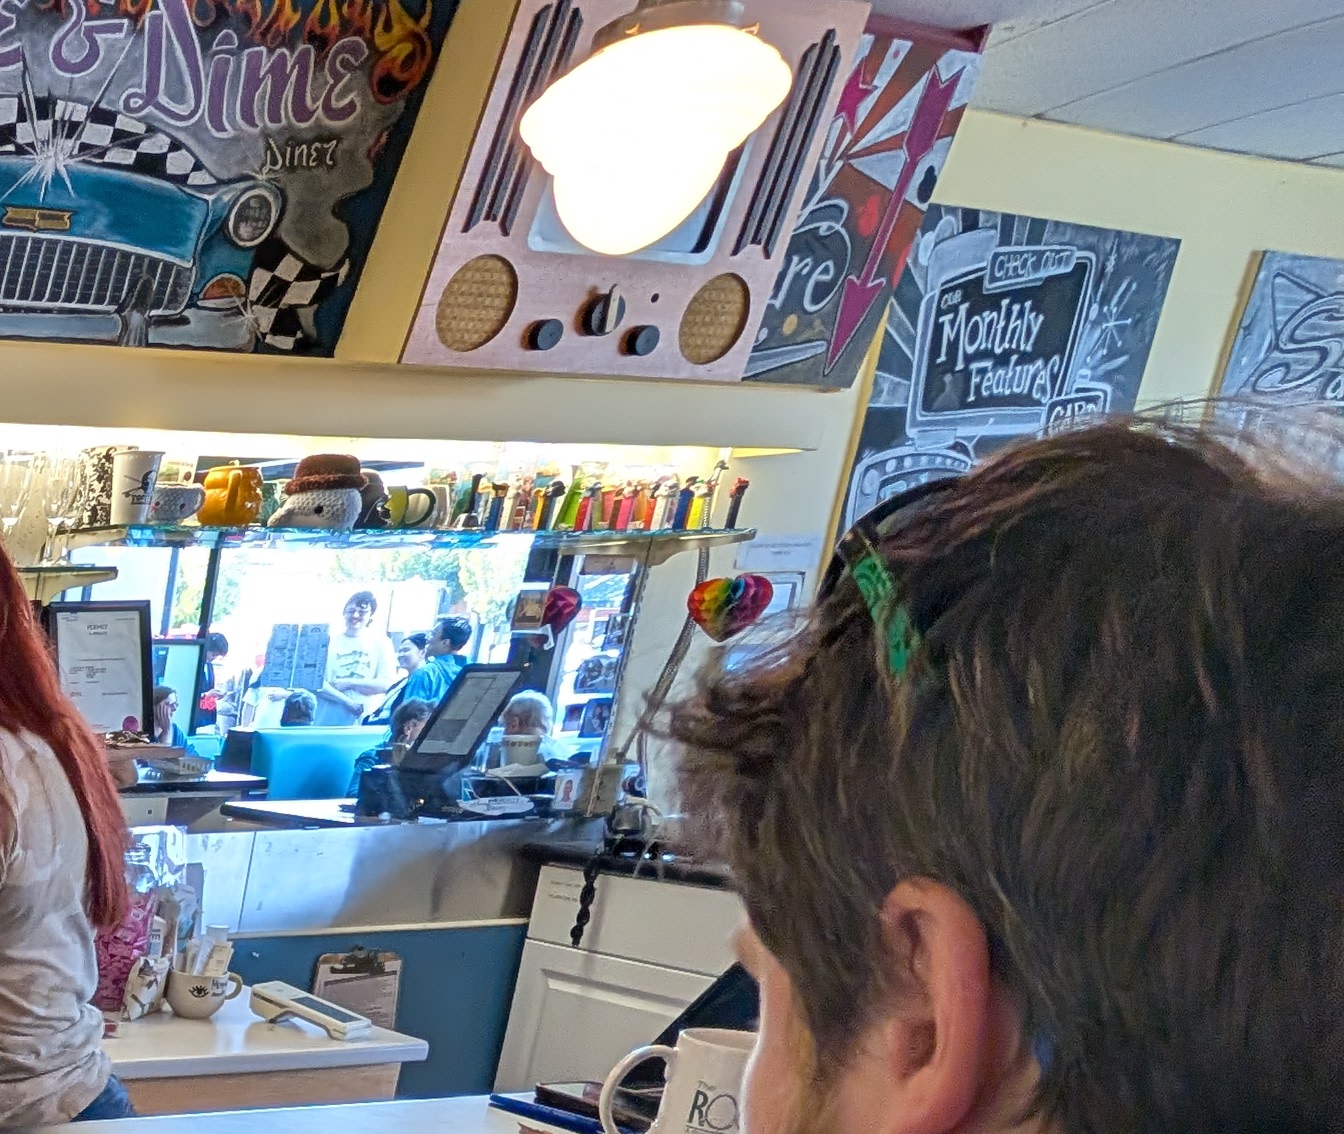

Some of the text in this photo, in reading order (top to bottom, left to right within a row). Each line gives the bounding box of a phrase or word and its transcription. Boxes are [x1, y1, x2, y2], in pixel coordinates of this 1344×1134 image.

[50, 0, 130, 77] &
[768, 236, 849, 313] re
[994, 253, 1034, 277] CHECK
[936, 299, 1045, 371] Monthly
[967, 353, 1061, 403] Features
[687, 1089, 740, 1131] RO
